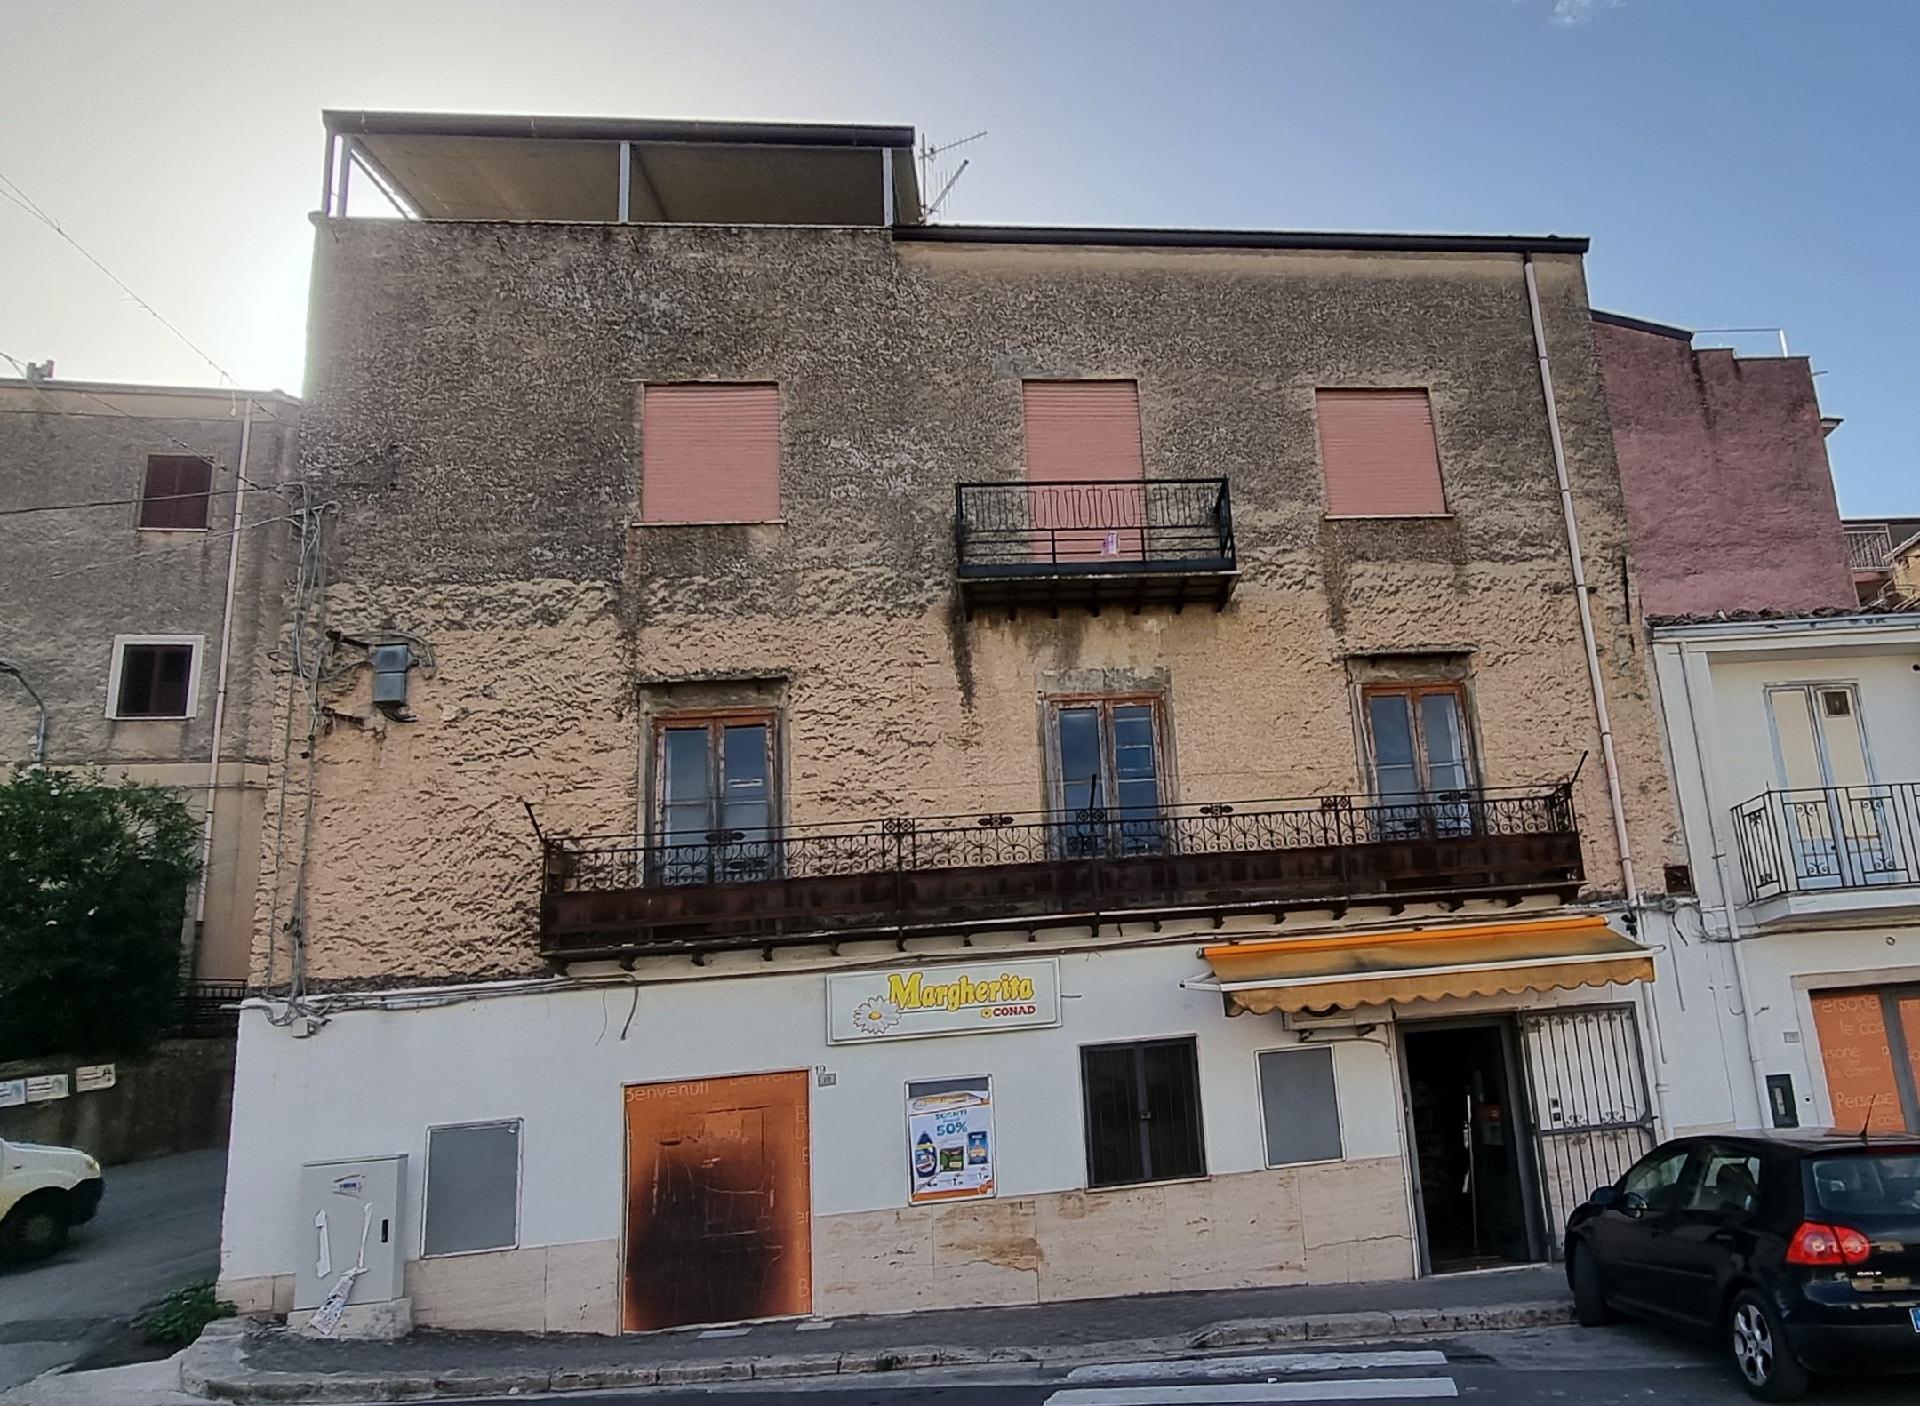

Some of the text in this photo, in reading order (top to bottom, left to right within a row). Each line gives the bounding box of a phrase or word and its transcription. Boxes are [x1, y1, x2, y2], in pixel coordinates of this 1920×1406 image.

[888, 972, 1035, 1011] Margherita
[993, 1005, 1036, 1017] CONAD
[936, 1121, 968, 1137] 50%
